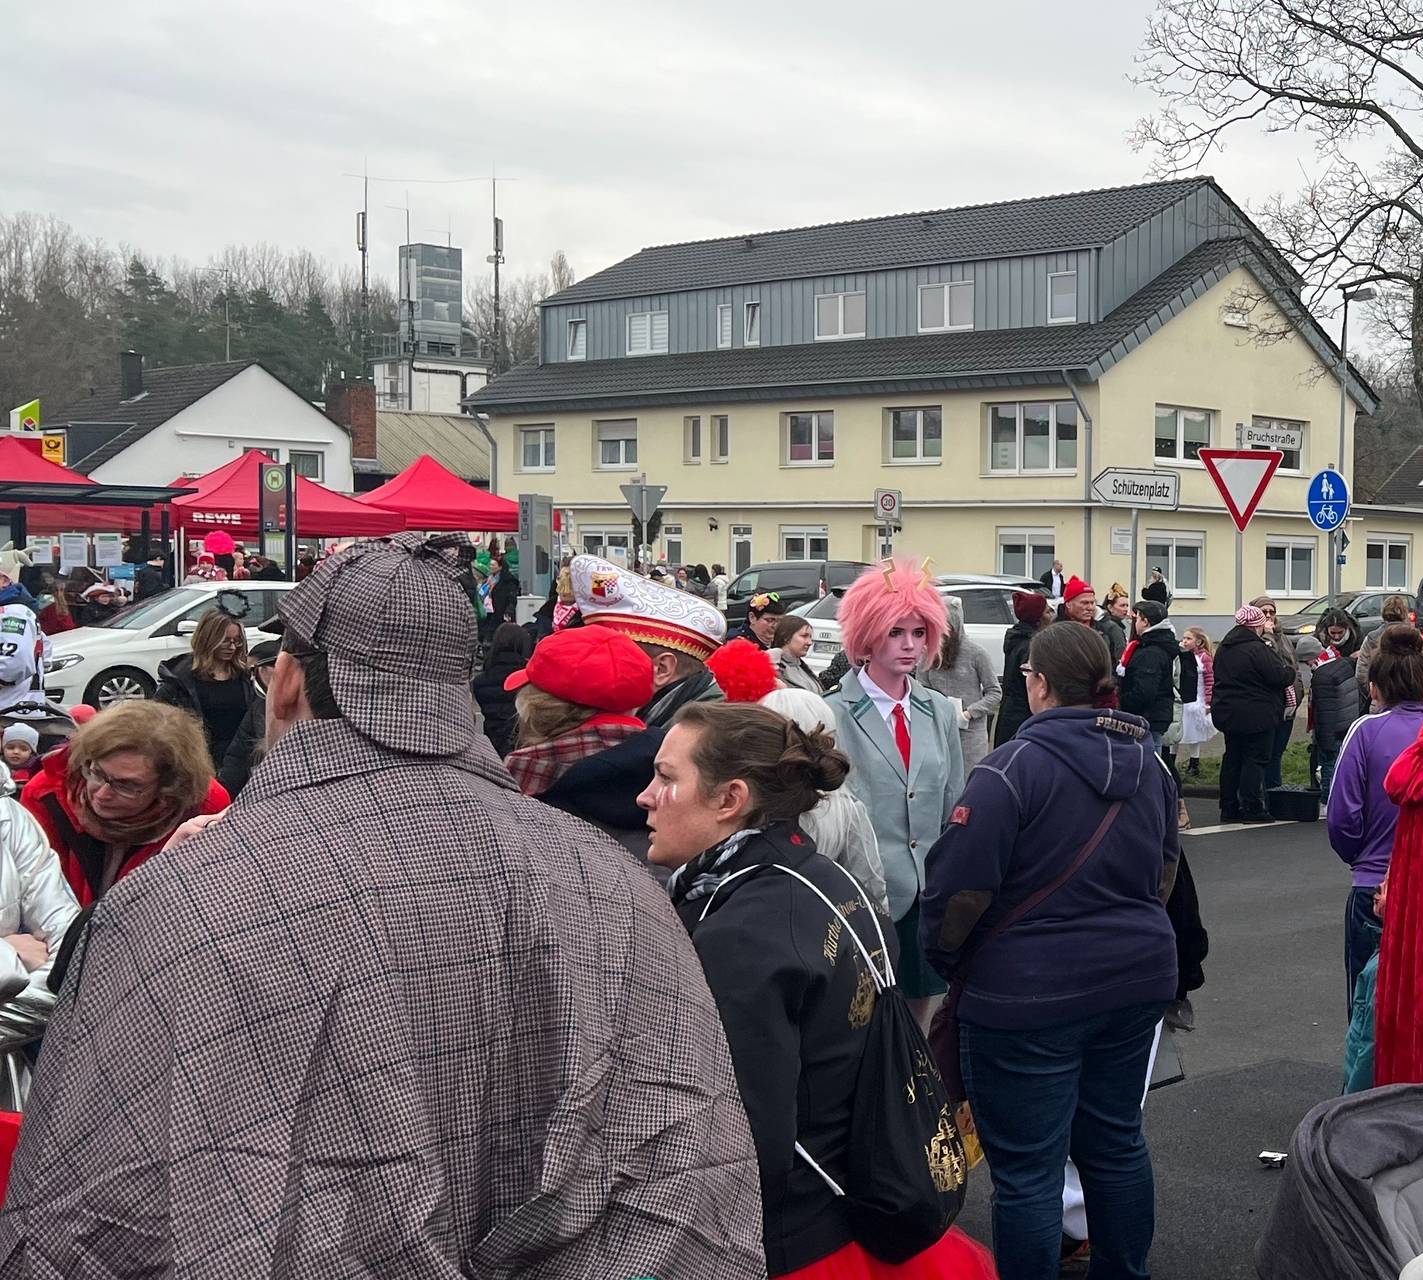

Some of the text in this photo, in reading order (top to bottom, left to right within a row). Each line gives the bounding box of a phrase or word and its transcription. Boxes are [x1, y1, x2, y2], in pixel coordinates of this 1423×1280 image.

[1247, 430, 1296, 445] Bruchstraße
[1112, 478, 1170, 501] Schützenplatz
[884, 498, 893, 507] 30
[192, 511, 242, 525] REWE
[0, 642, 18, 657] 2
[823, 915, 842, 967] Hürthe
